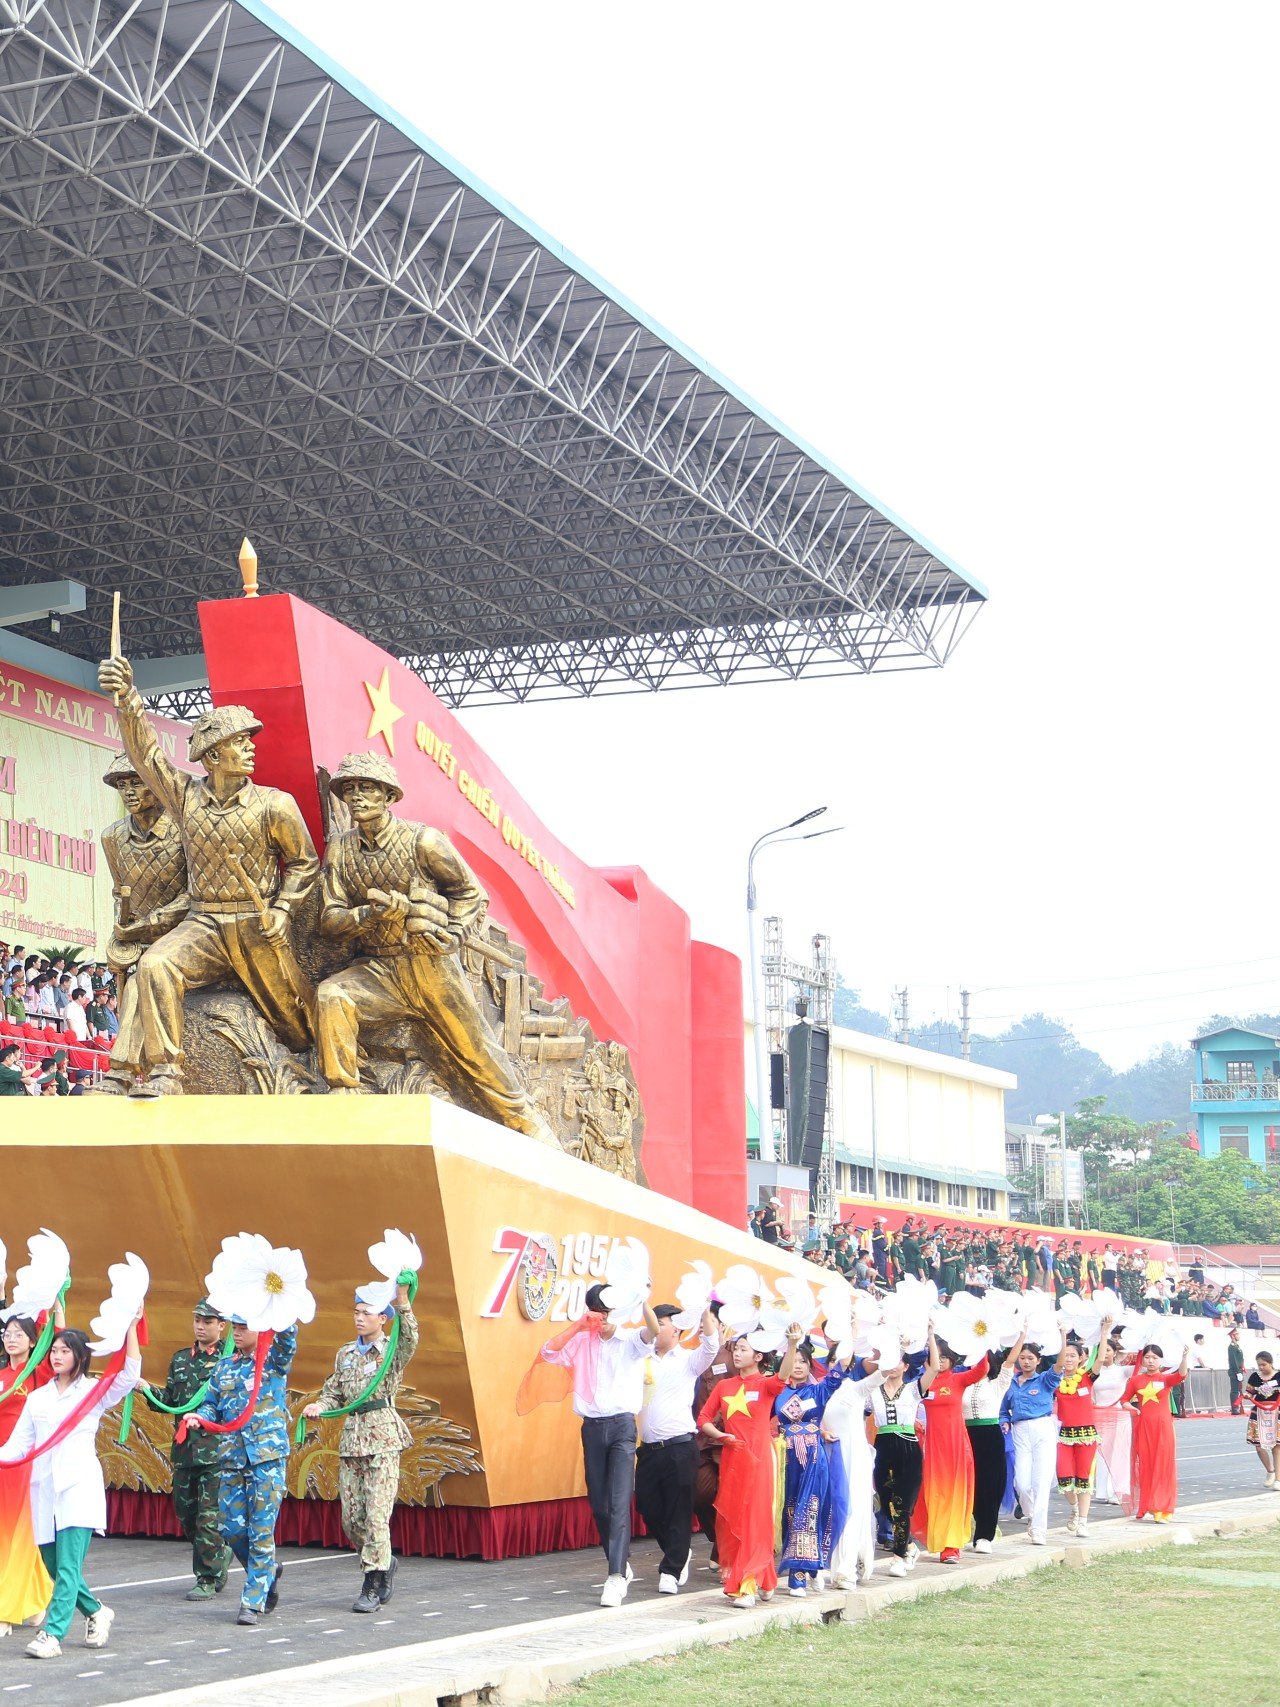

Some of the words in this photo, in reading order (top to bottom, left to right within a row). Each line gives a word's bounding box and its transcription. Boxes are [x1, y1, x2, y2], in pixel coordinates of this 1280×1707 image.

[34, 687, 95, 733] NAM
[415, 720, 458, 780] QUYẾT
[458, 769, 501, 829] CHIẾN
[7, 817, 54, 866] BIÊN
[59, 829, 97, 877] PHỦ
[560, 1231, 619, 1278] 195
